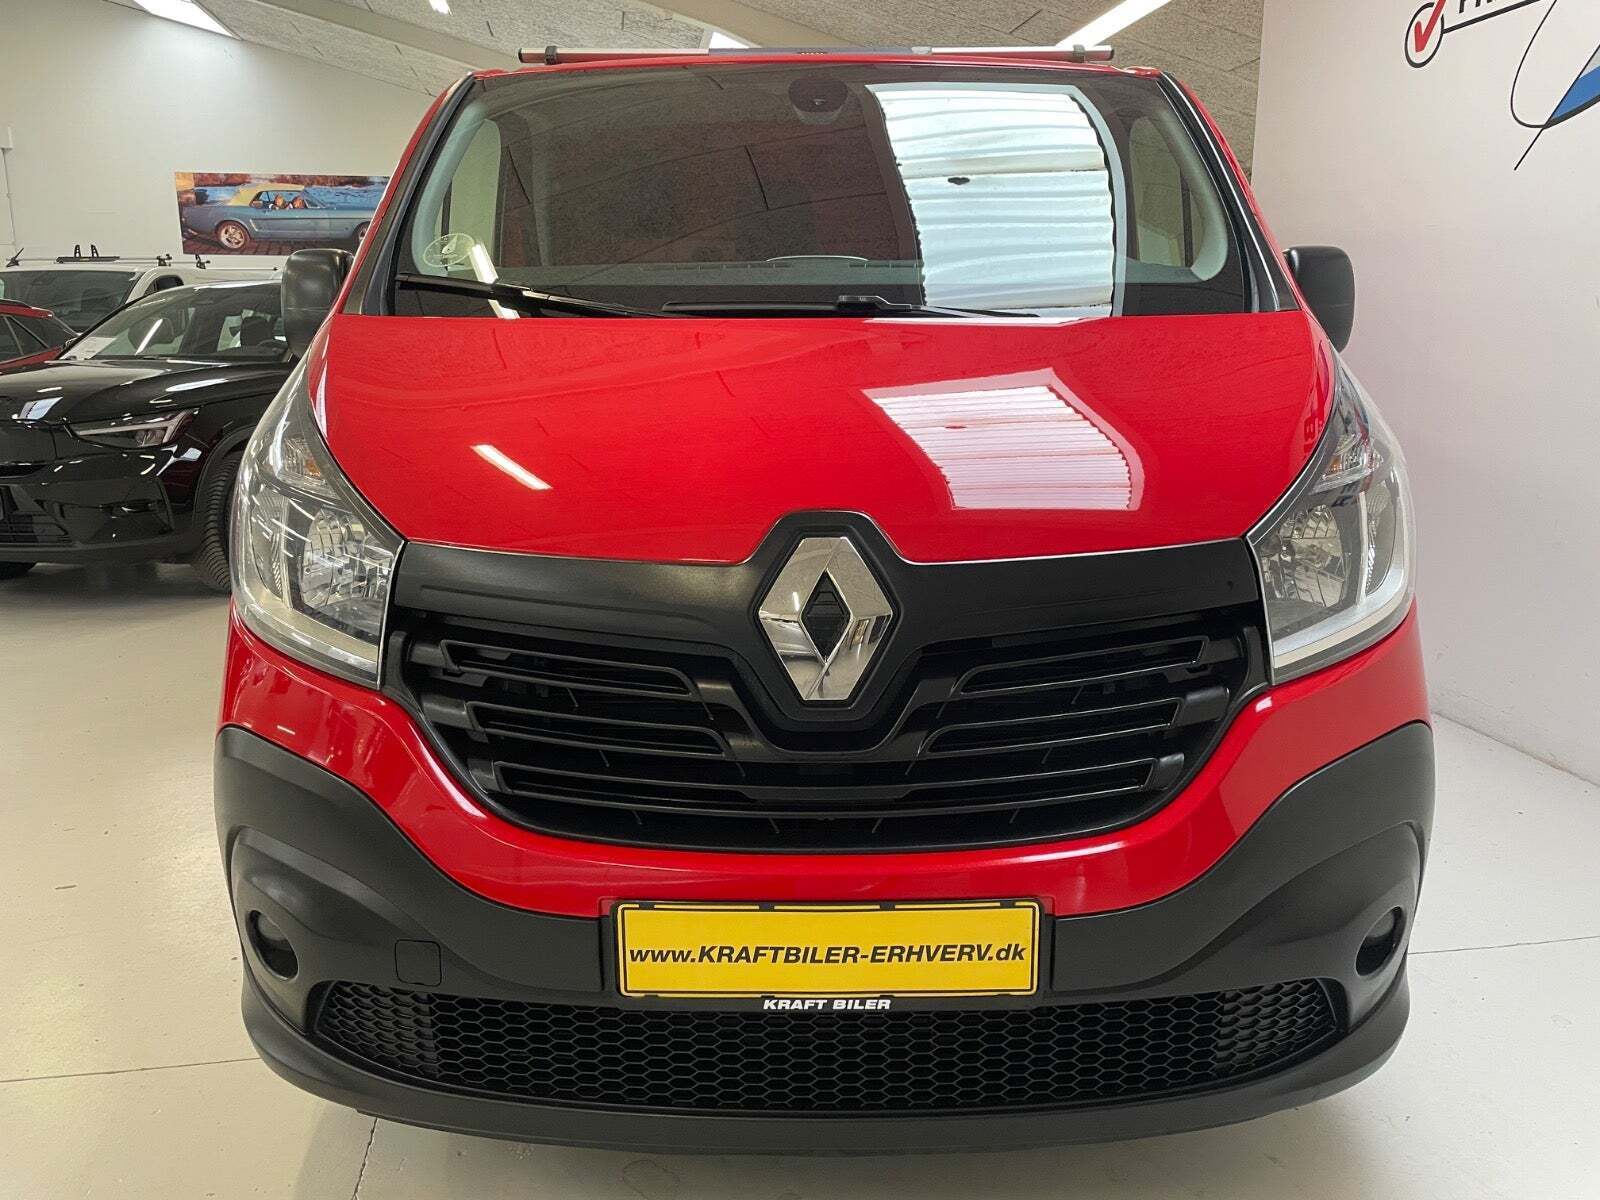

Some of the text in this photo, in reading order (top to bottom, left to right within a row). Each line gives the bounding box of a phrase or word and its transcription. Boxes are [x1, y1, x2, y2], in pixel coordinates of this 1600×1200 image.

[629, 943, 1027, 964] www.KRAFTBILER-ERHVERV.dk
[763, 999, 892, 1010] KRAFT BILER
